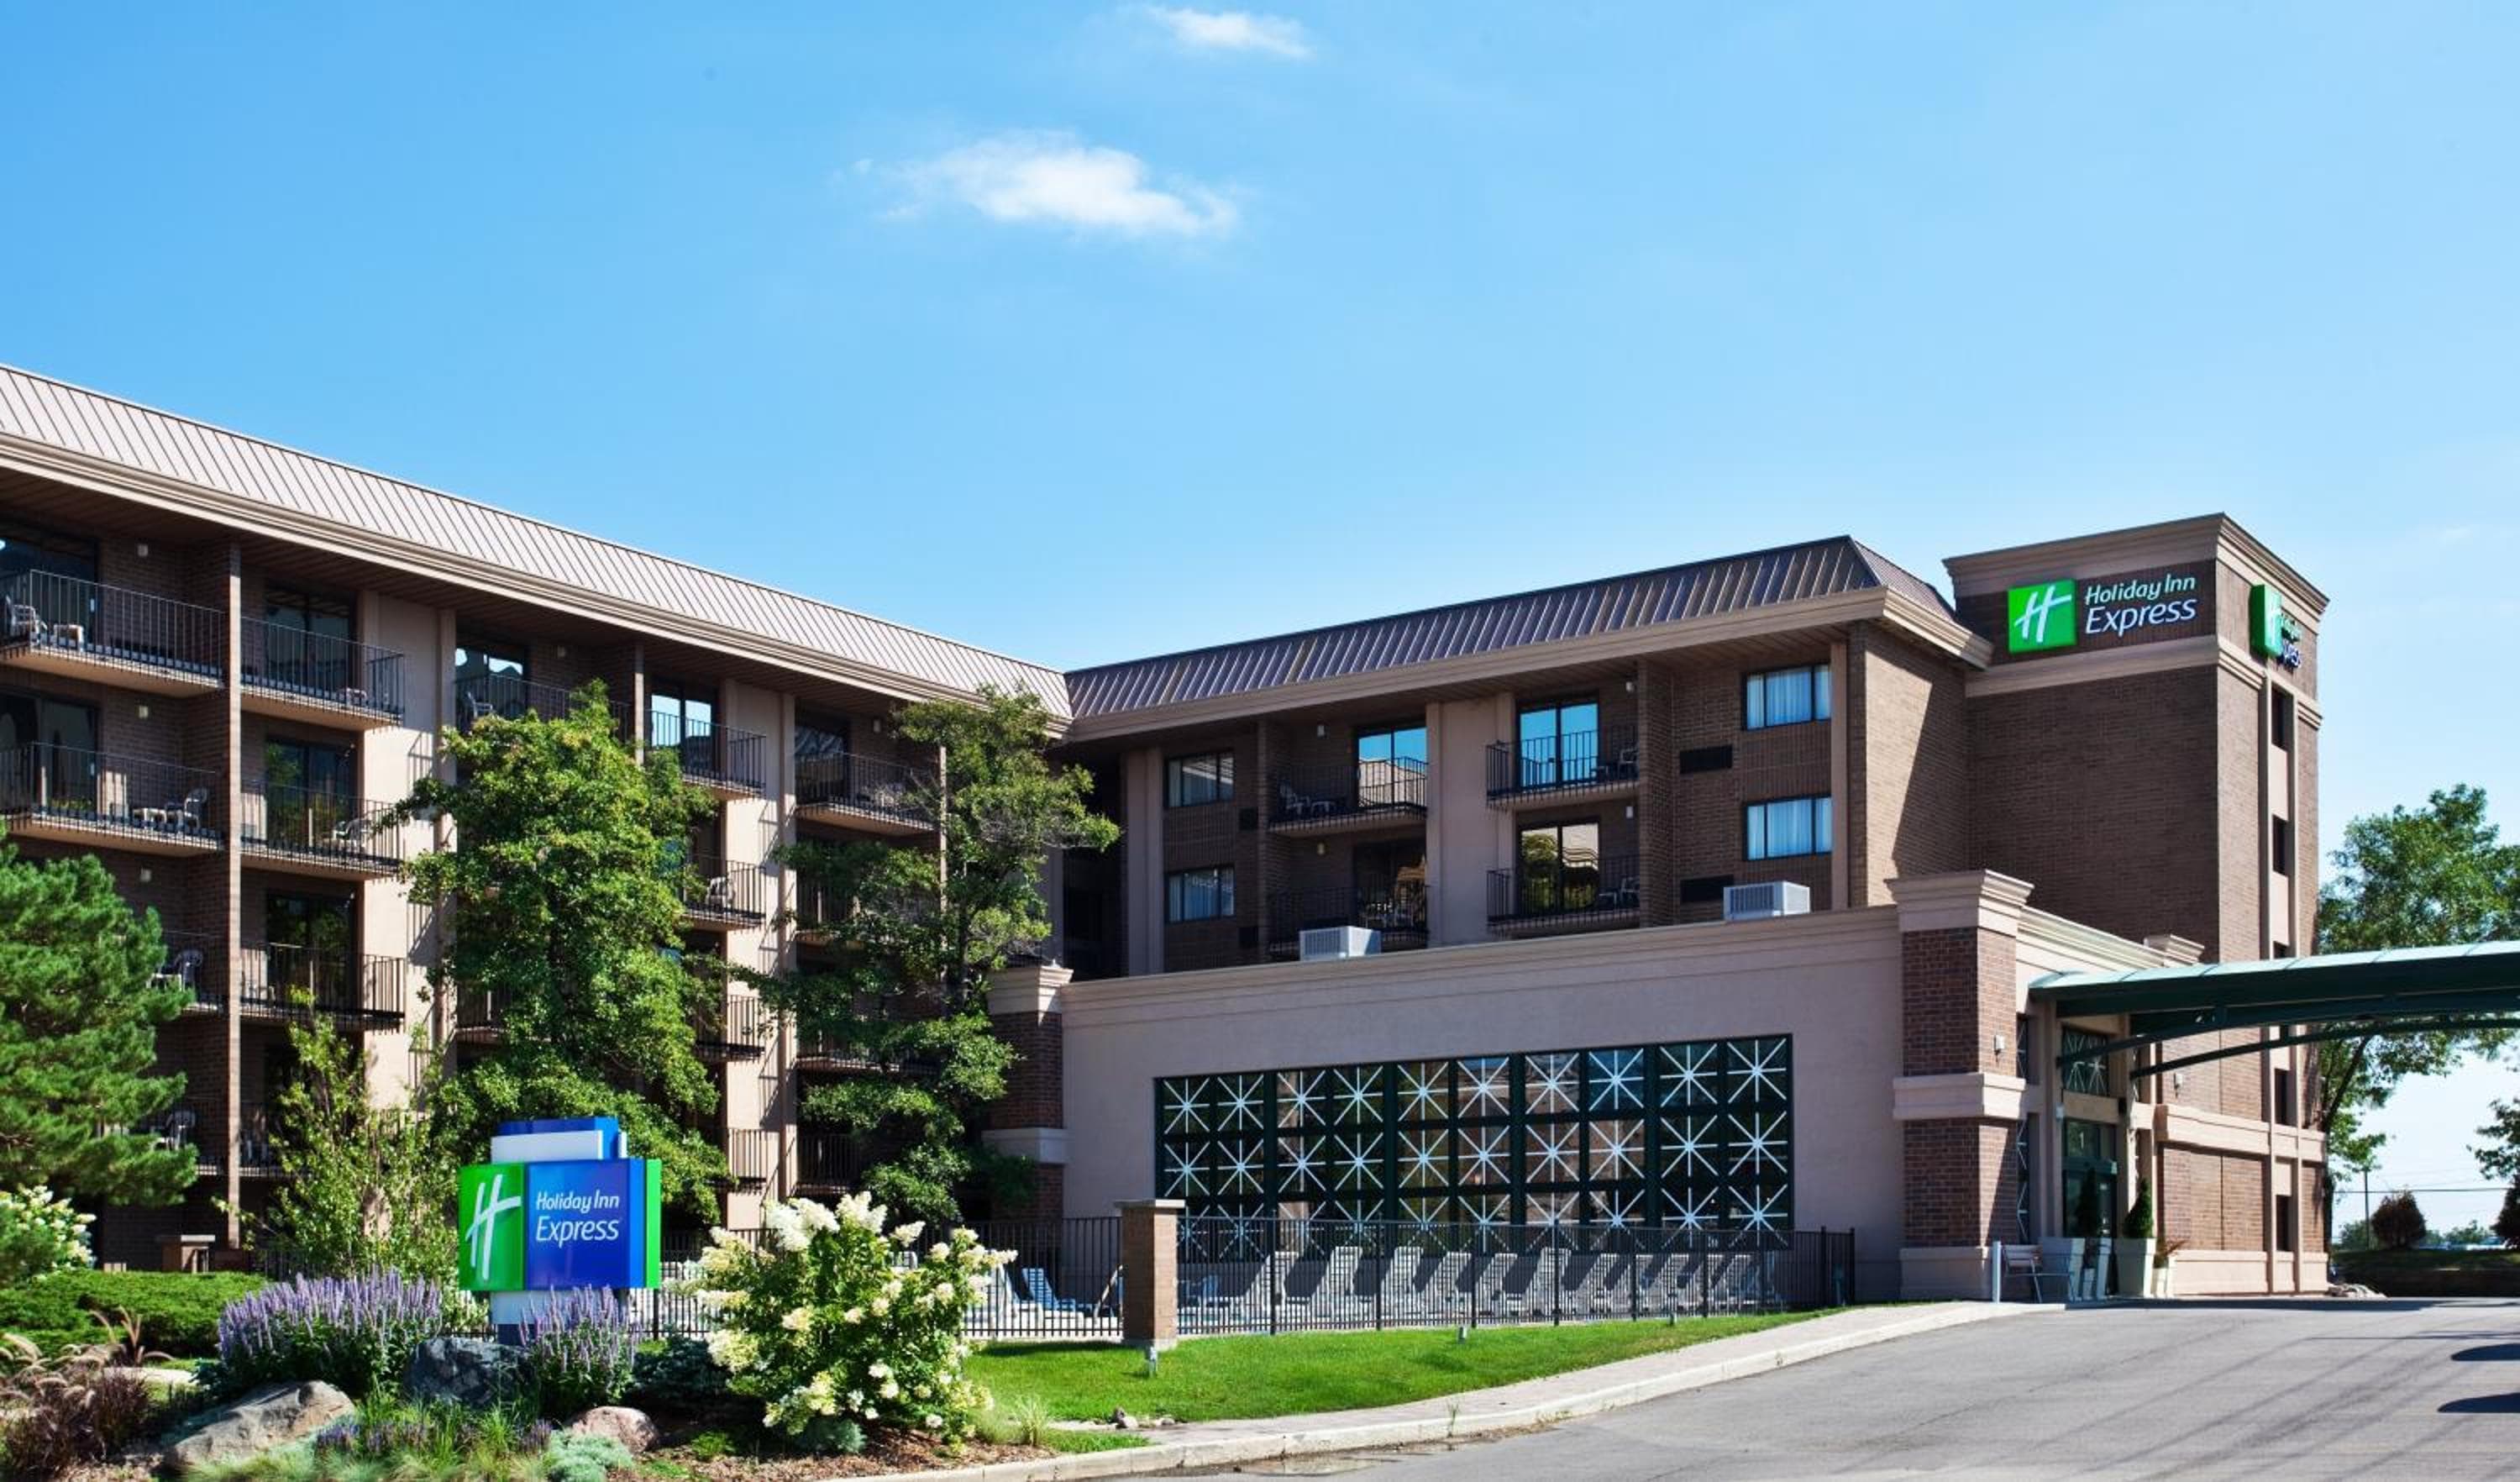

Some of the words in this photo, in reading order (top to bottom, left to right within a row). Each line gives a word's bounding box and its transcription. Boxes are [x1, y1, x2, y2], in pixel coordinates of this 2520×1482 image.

[2086, 580, 2161, 605] Holiday
[2166, 574, 2195, 592] Inn
[2086, 599, 2197, 637] Express
[536, 1190, 592, 1214] Holiday
[594, 1189, 620, 1209] Inn
[536, 1216, 619, 1248] Express
